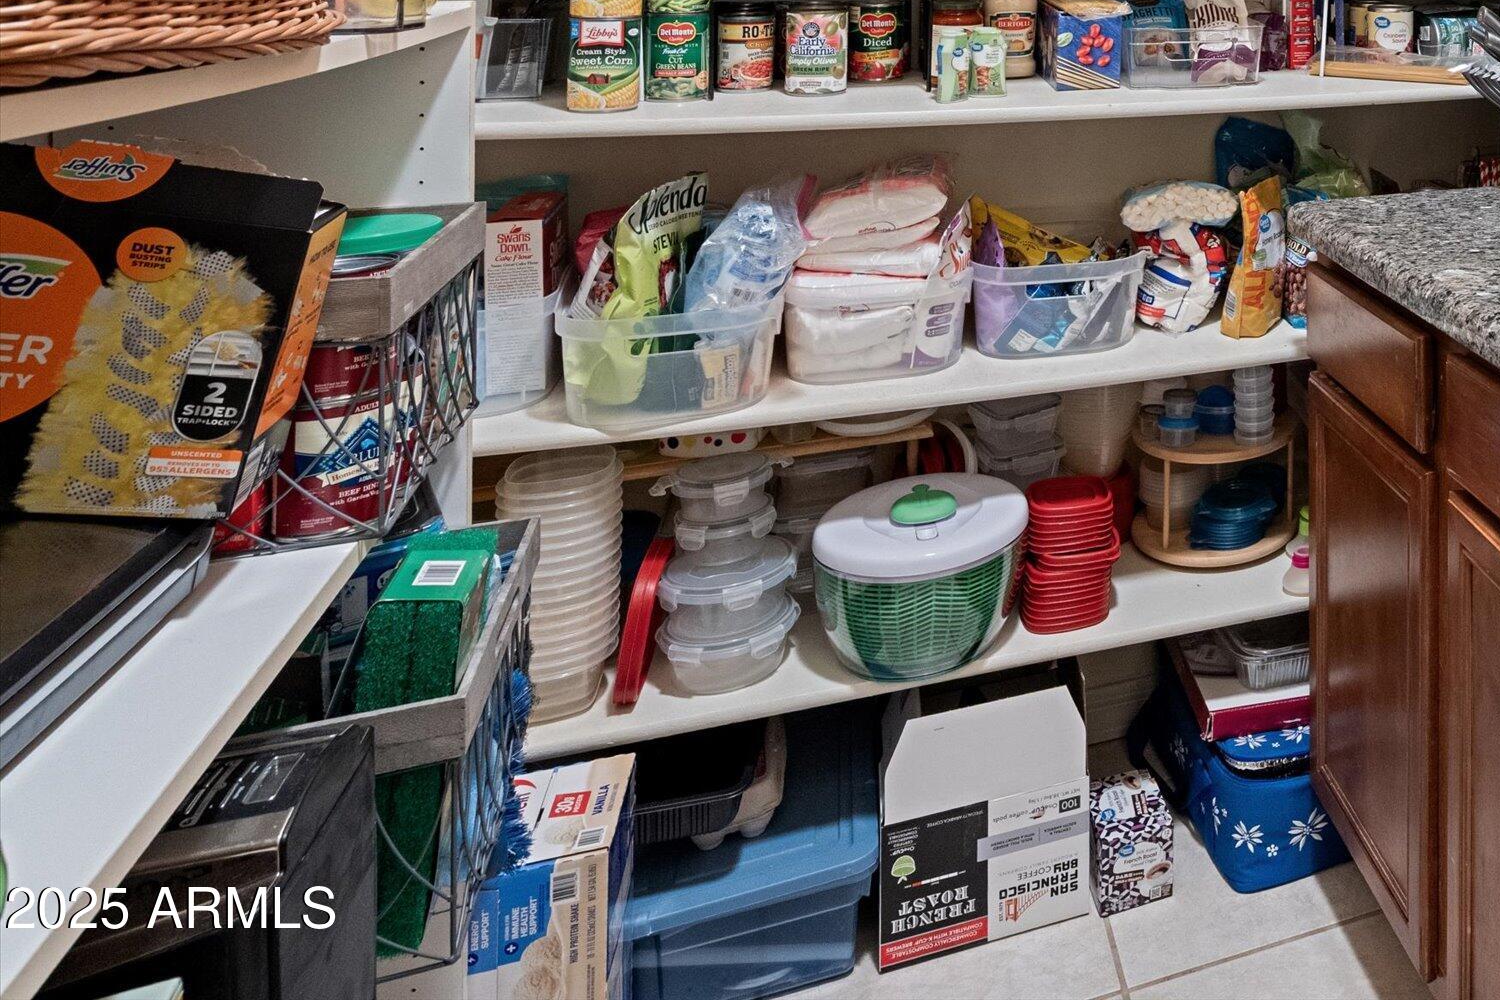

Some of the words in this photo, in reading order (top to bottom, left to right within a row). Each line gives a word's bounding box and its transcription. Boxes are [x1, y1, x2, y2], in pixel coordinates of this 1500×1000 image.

[873, 19, 895, 27] Monte
[585, 25, 618, 40] Libby's
[672, 28, 693, 36] Monte
[798, 36, 826, 47] Early
[863, 36, 892, 47] Diced
[576, 48, 602, 56] Cream
[604, 47, 626, 55] Style
[789, 45, 836, 56] California
[570, 56, 602, 67] Sweet
[604, 56, 633, 66] Corn
[63, 152, 147, 184] Swiffer
[628, 176, 708, 235] Splenda
[497, 232, 531, 244] Swans
[132, 242, 175, 256] DUST
[500, 243, 529, 253] Down
[129, 253, 172, 263] BUSTING
[131, 260, 166, 270] STRIPS
[203, 382, 227, 404] 2
[182, 404, 238, 418] SIDED
[171, 450, 223, 459] UNSCENTED
[339, 486, 361, 499] BEEF
[330, 498, 345, 506] with
[592, 783, 611, 816] VANILLA
[1061, 798, 1079, 809] 100
[992, 813, 1009, 823] pods
[1008, 810, 1029, 819] coffee
[926, 820, 944, 828] COFFEE
[1142, 852, 1158, 861] Roast
[1017, 865, 1052, 881] COFFEE
[1053, 859, 1078, 873] BAY
[999, 870, 1078, 899] FRANCISCO
[1050, 881, 1078, 898] SAN
[897, 884, 969, 915] ROAST
[528, 897, 538, 935] SUPPORT
[569, 903, 579, 924] SHAKE
[890, 898, 977, 934] FRENCH
[510, 906, 520, 940] IMMUNE
[519, 906, 529, 938] HEALTH
[948, 921, 983, 937] COMPATIBLE
[470, 920, 480, 951] ENERGY
[481, 911, 490, 950] SUPPORT
[569, 925, 579, 949] PROTEIN
[934, 931, 948, 940] WITH
[885, 939, 914, 954] BREWERS
[891, 942, 936, 959] COMPOSTABLE
[569, 949, 579, 965] HIGH
